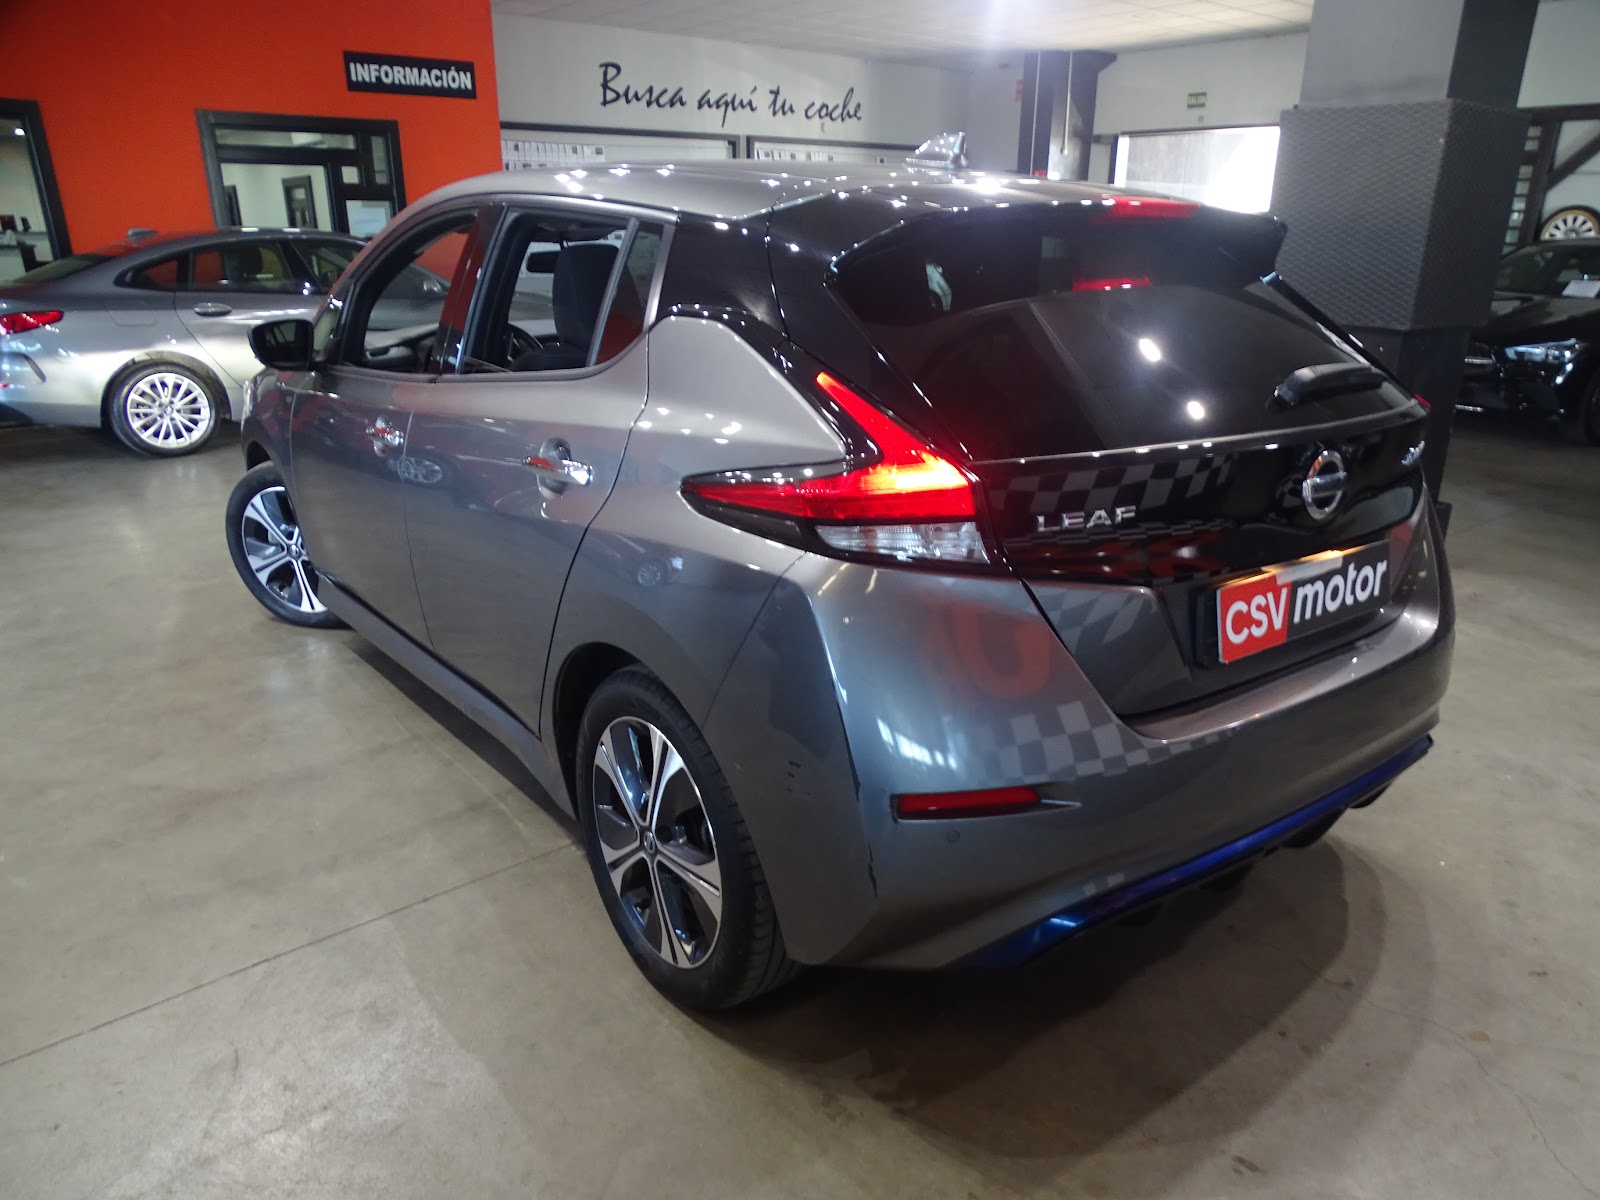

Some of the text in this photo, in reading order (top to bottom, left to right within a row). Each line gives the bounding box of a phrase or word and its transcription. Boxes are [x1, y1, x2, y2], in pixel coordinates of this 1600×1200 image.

[349, 62, 473, 90] INFORMACIÓN
[598, 61, 862, 129] Busca aquí tu coche
[1037, 505, 1137, 532] LEAF
[1225, 559, 1388, 645] CSV motor
